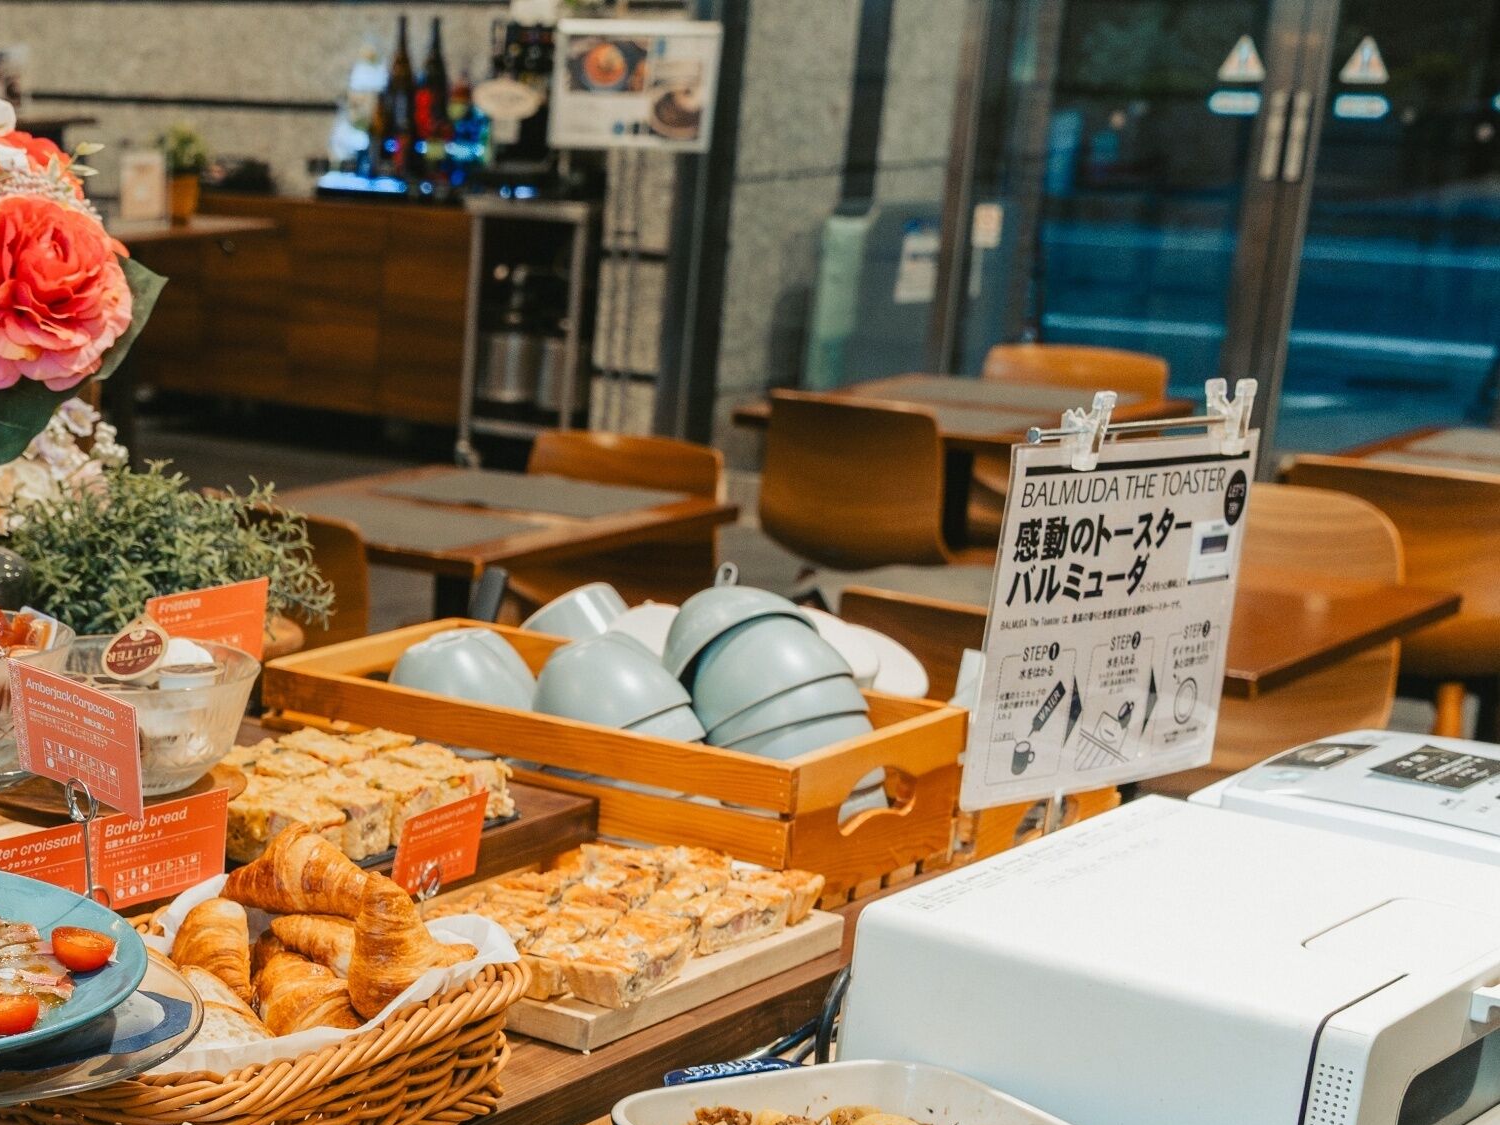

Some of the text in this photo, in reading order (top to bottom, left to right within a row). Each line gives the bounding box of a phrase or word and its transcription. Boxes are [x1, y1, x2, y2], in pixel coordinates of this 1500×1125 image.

[1021, 467, 1227, 508] BALMUDA THE TOASTER
[1013, 507, 1192, 563] 感動のトースター
[1006, 553, 1150, 607] バルミューダ
[107, 644, 162, 663] BUTTER
[26, 678, 72, 703] Amberjack
[1038, 690, 1060, 722] WATER
[105, 808, 187, 838] Barley bread
[20, 832, 82, 855] croissant
